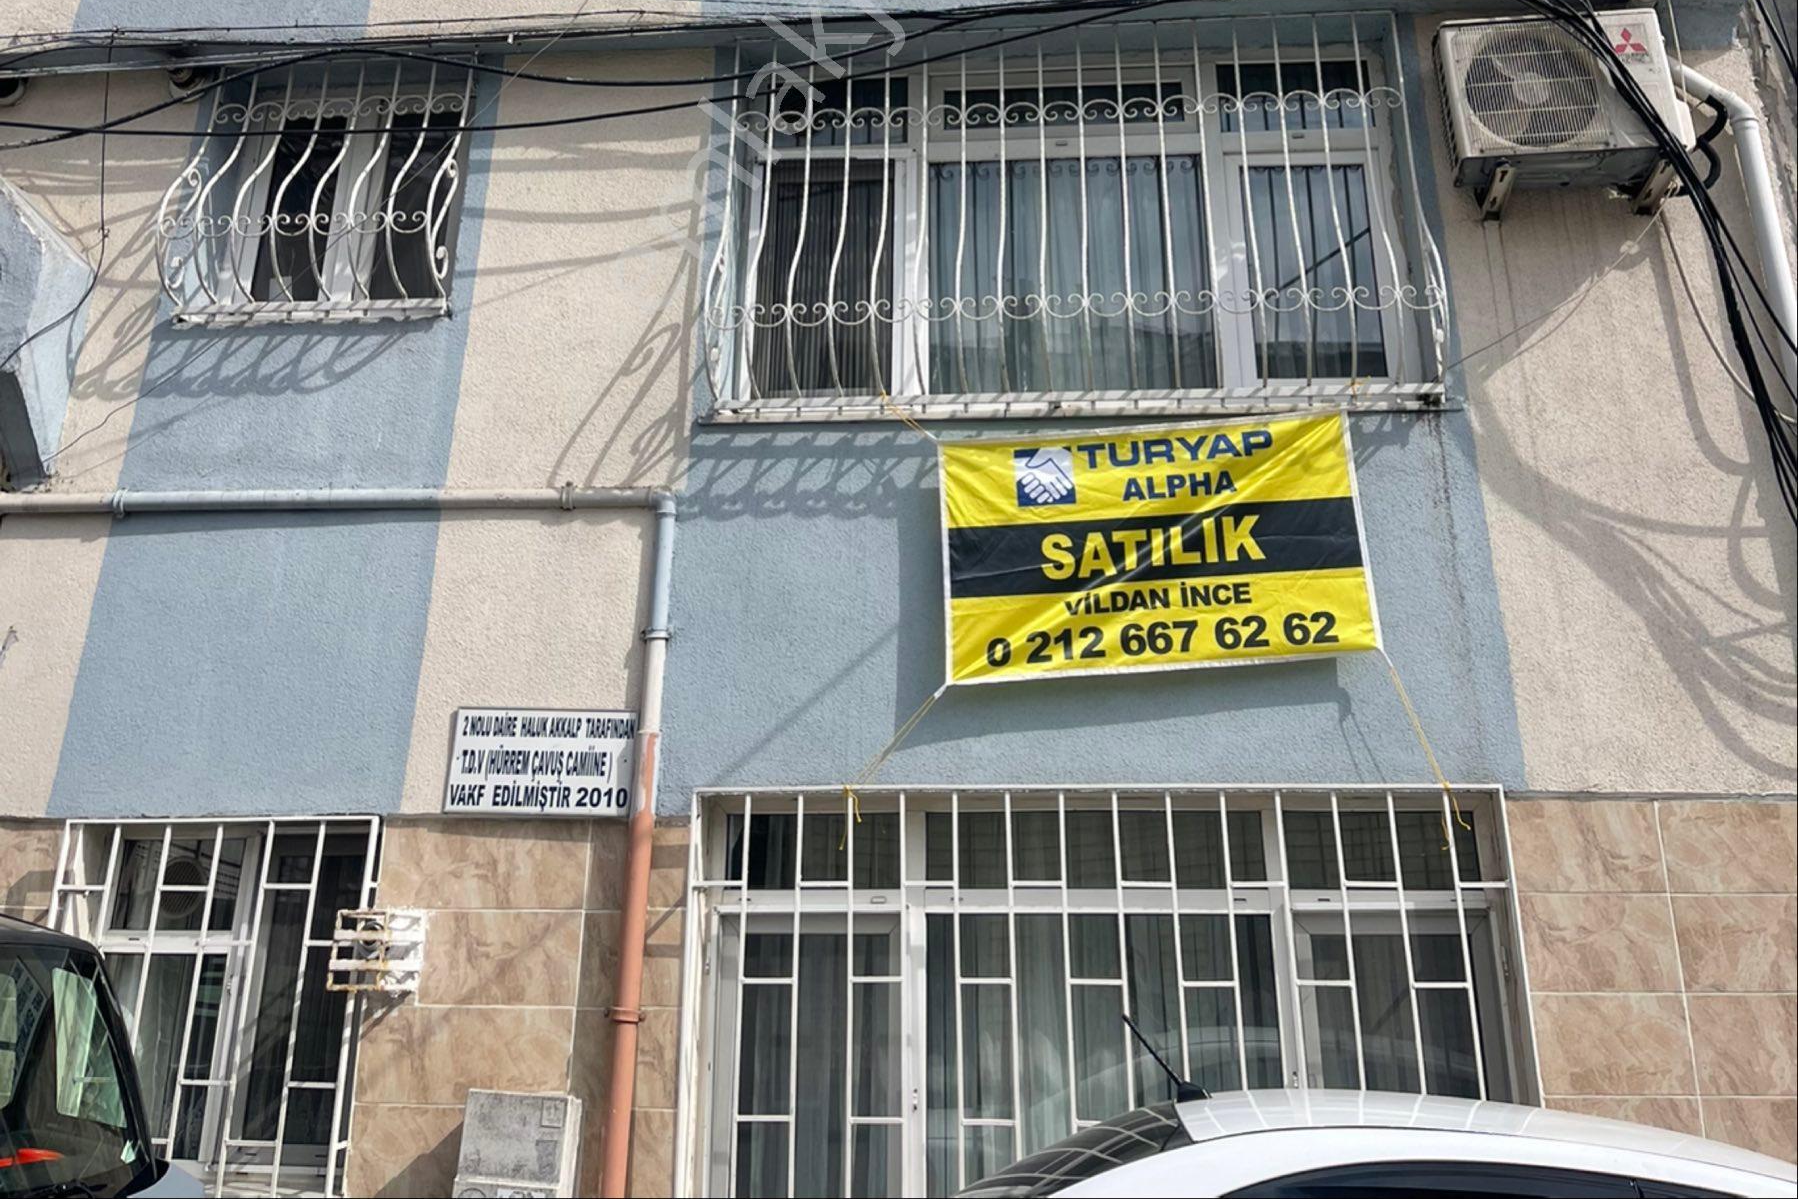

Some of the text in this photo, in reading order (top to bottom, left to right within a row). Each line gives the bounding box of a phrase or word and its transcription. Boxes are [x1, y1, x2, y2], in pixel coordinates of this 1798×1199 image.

[1075, 429, 1274, 470] TURYAP
[1122, 470, 1237, 502] ALPHA
[1040, 514, 1267, 581] SATILIK
[1064, 581, 1253, 617] VİLDAN İNCE
[986, 611, 1339, 667] 0 212 667 62 62
[462, 712, 636, 740] 2 NOLU DAİRE HALUK AKKALP TARAFINDAN
[531, 750, 565, 783] ÇAVUŞ
[450, 780, 629, 812] VAKF EDİLMİŞTİR 2010
